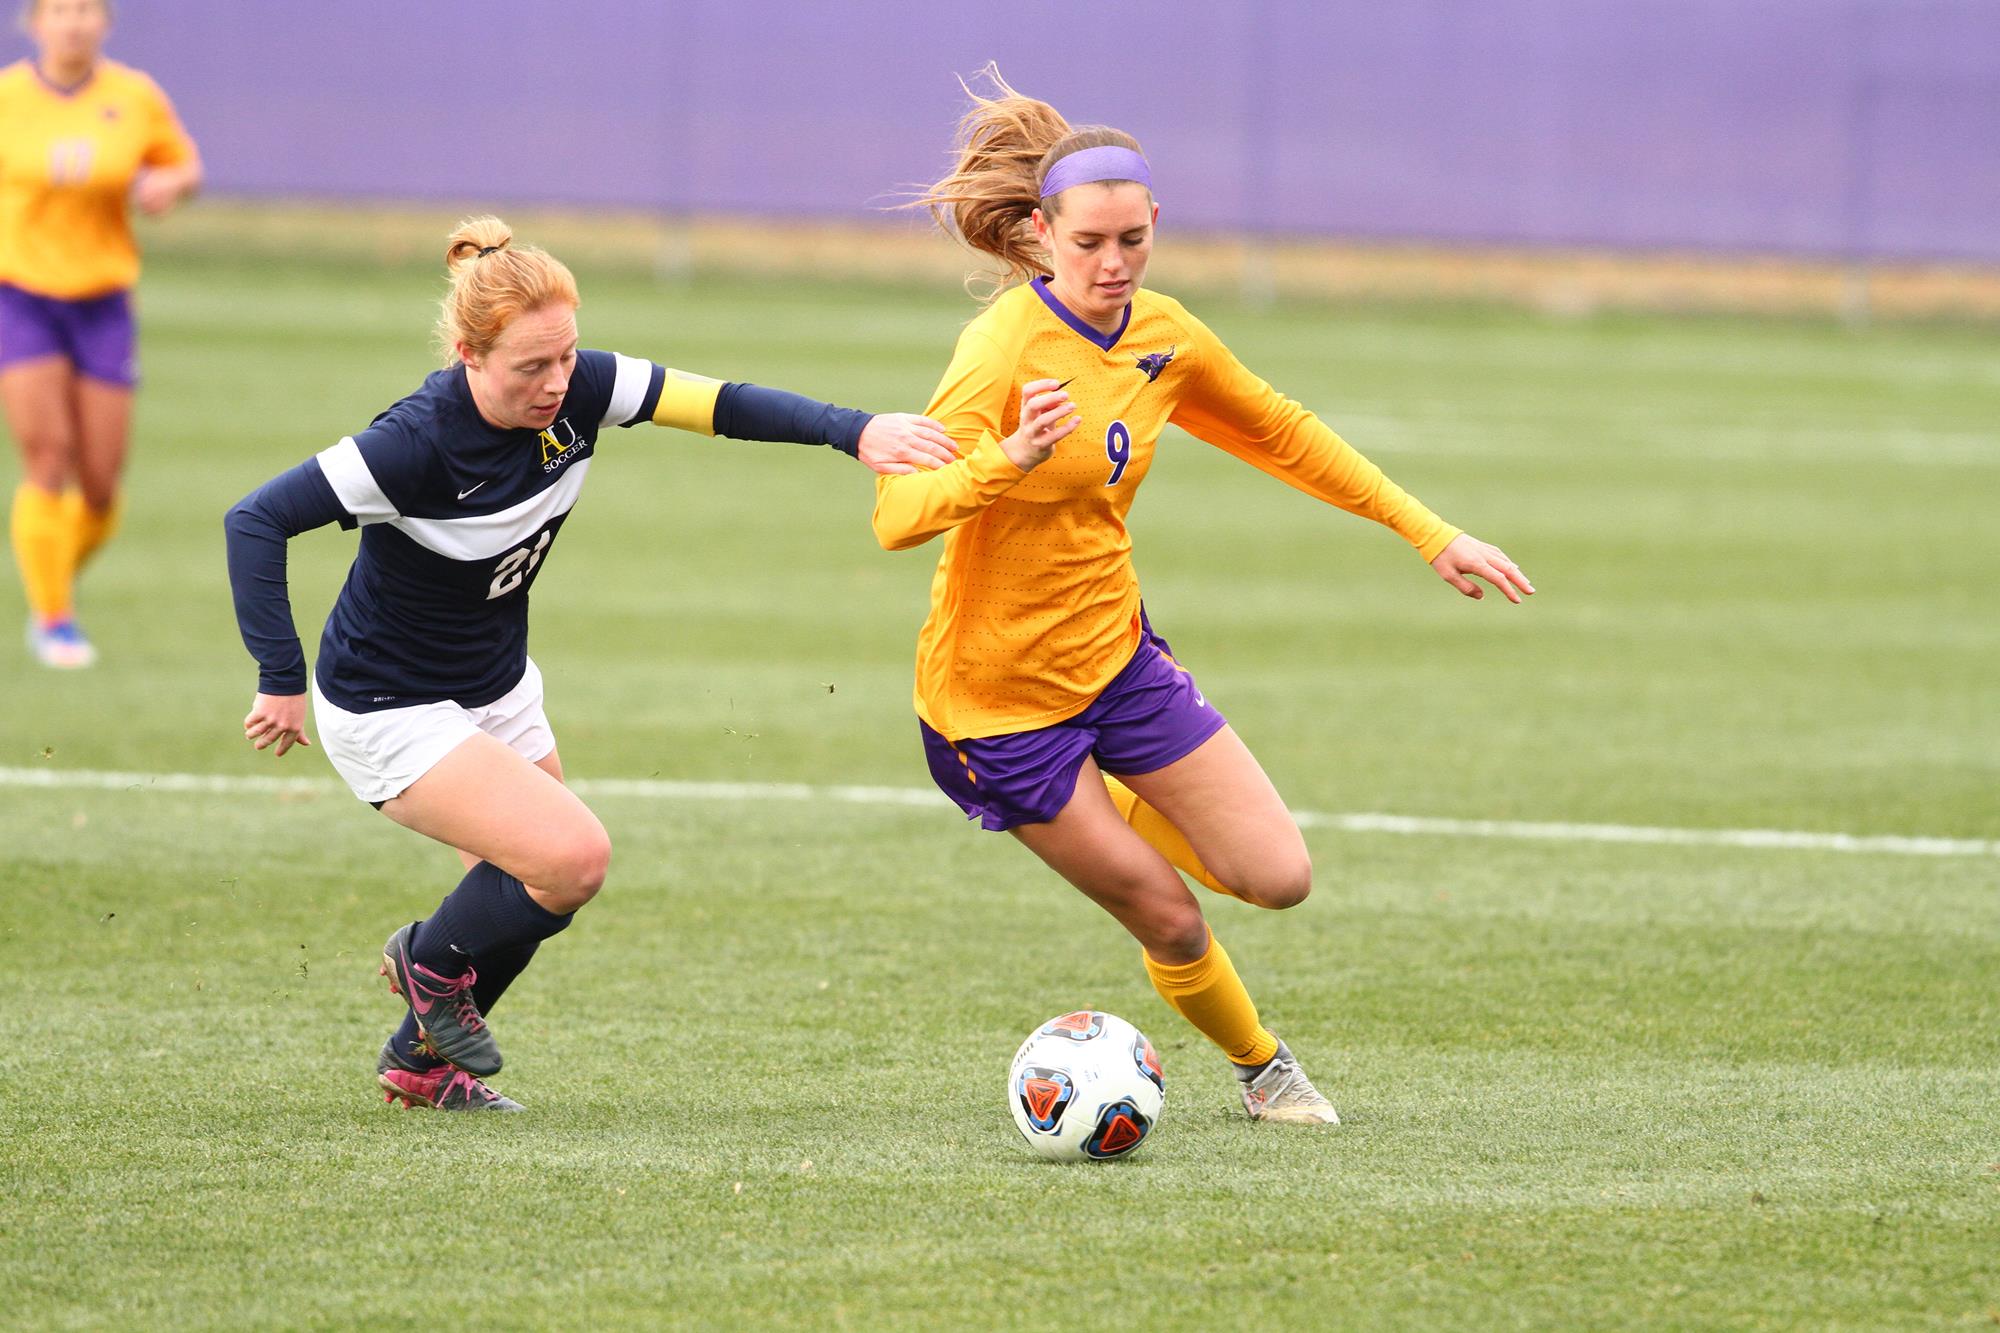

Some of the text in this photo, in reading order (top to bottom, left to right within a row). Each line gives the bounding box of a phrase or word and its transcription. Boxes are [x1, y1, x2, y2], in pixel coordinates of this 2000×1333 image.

[537, 417, 576, 464] AU
[543, 439, 588, 473] SOCCER
[1104, 420, 1131, 487] 9
[485, 529, 550, 600] 21
